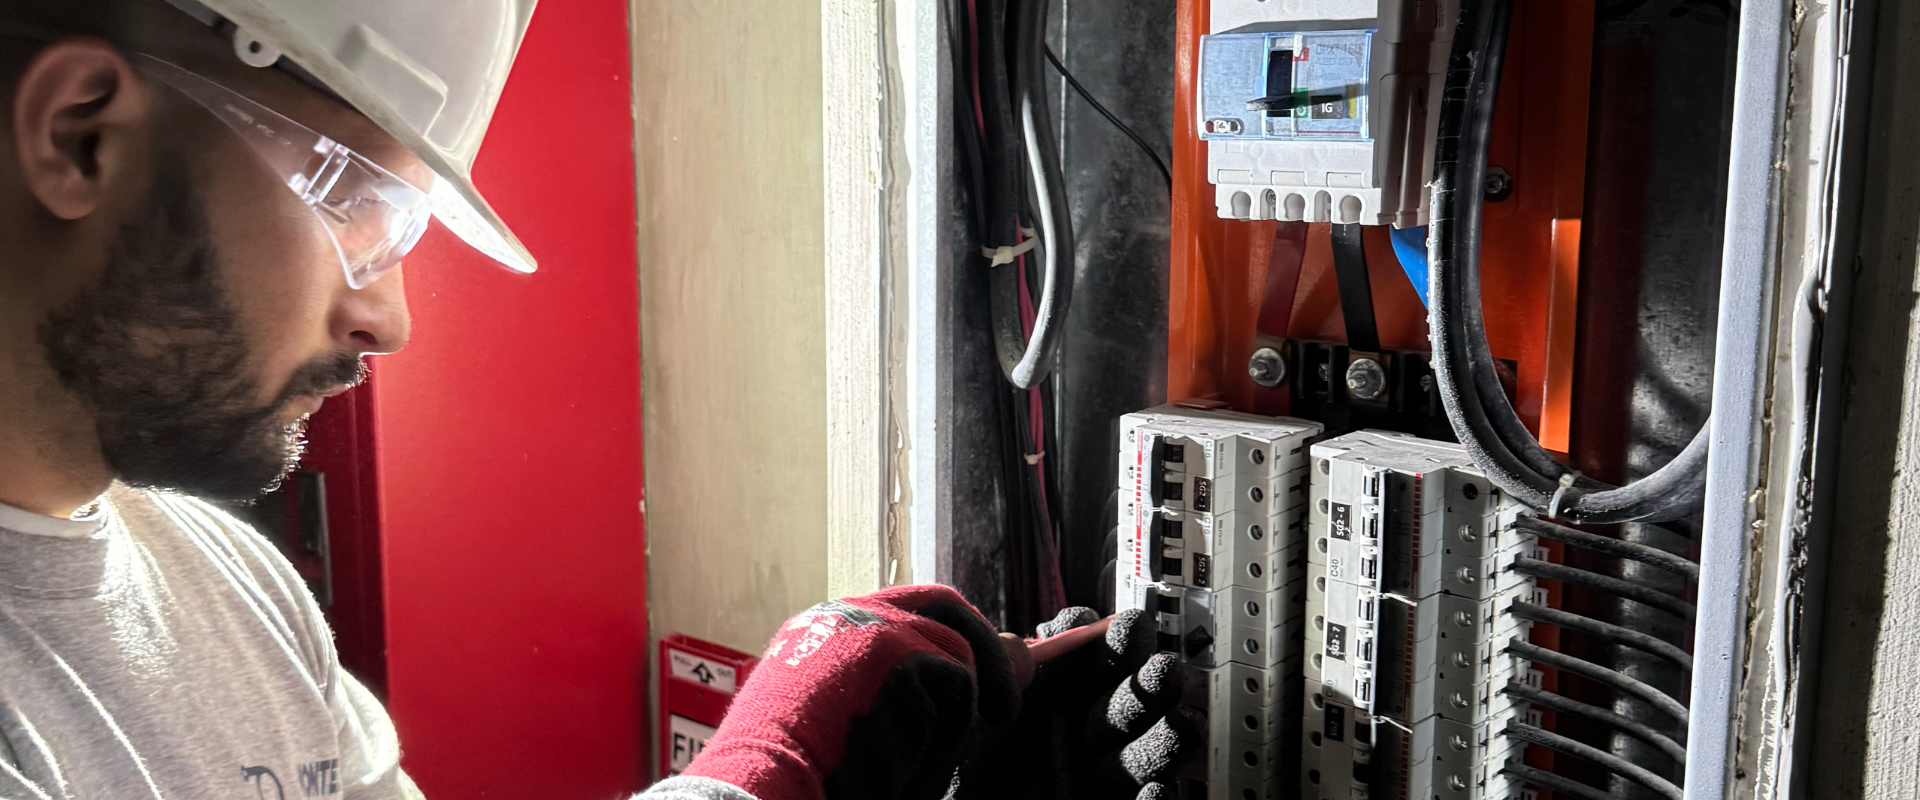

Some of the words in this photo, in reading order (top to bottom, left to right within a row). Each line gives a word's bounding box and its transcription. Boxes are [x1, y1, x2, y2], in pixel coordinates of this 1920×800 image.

[1321, 102, 1333, 113] IG
[1204, 440, 1213, 459] C16
[1203, 517, 1211, 535] C16
[1330, 558, 1339, 577] C40
[673, 732, 706, 760] FI
